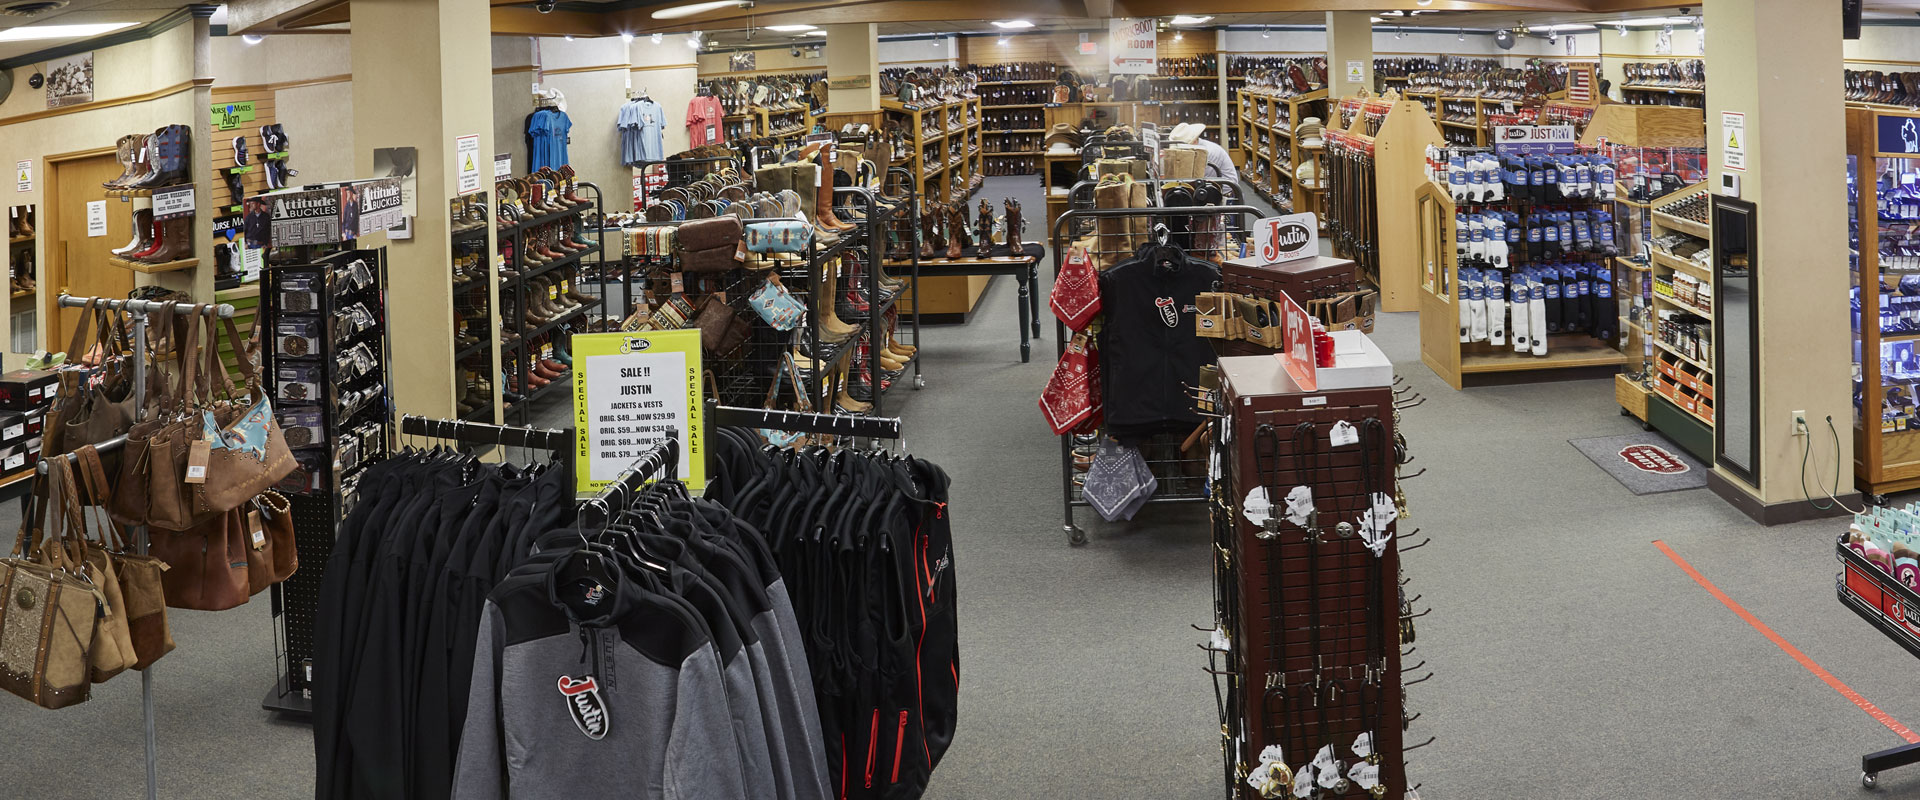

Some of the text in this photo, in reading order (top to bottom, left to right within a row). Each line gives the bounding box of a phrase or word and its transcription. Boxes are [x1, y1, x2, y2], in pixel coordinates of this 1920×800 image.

[1112, 19, 1153, 42] WORKBOOT
[1128, 40, 1154, 49] ROOM
[211, 104, 252, 114] NURSE MATES
[222, 113, 240, 128] Align
[361, 185, 399, 213] Attitude
[372, 195, 400, 210] BUCKLES
[271, 196, 336, 220] Attitude
[289, 205, 337, 218] BUCKLES
[1263, 219, 1309, 262] Justin
[1283, 251, 1300, 259] BOOTS
[1155, 296, 1179, 328] Justin
[620, 336, 652, 354] Justin
[620, 367, 642, 378] SALE
[620, 384, 652, 396] JUSTIN
[610, 401, 637, 410] JACKETS
[643, 400, 663, 408] VESTS
[599, 414, 616, 422] ORIG.
[652, 412, 676, 421] $29.99
[600, 426, 616, 435] ORIG.
[600, 438, 617, 447] ORIG.
[601, 450, 618, 459] ORIG.
[1629, 452, 1659, 468] BOOTS
[1892, 598, 1920, 624] Justi
[604, 636, 616, 689] JUSTIN
[558, 675, 609, 740] Justin
